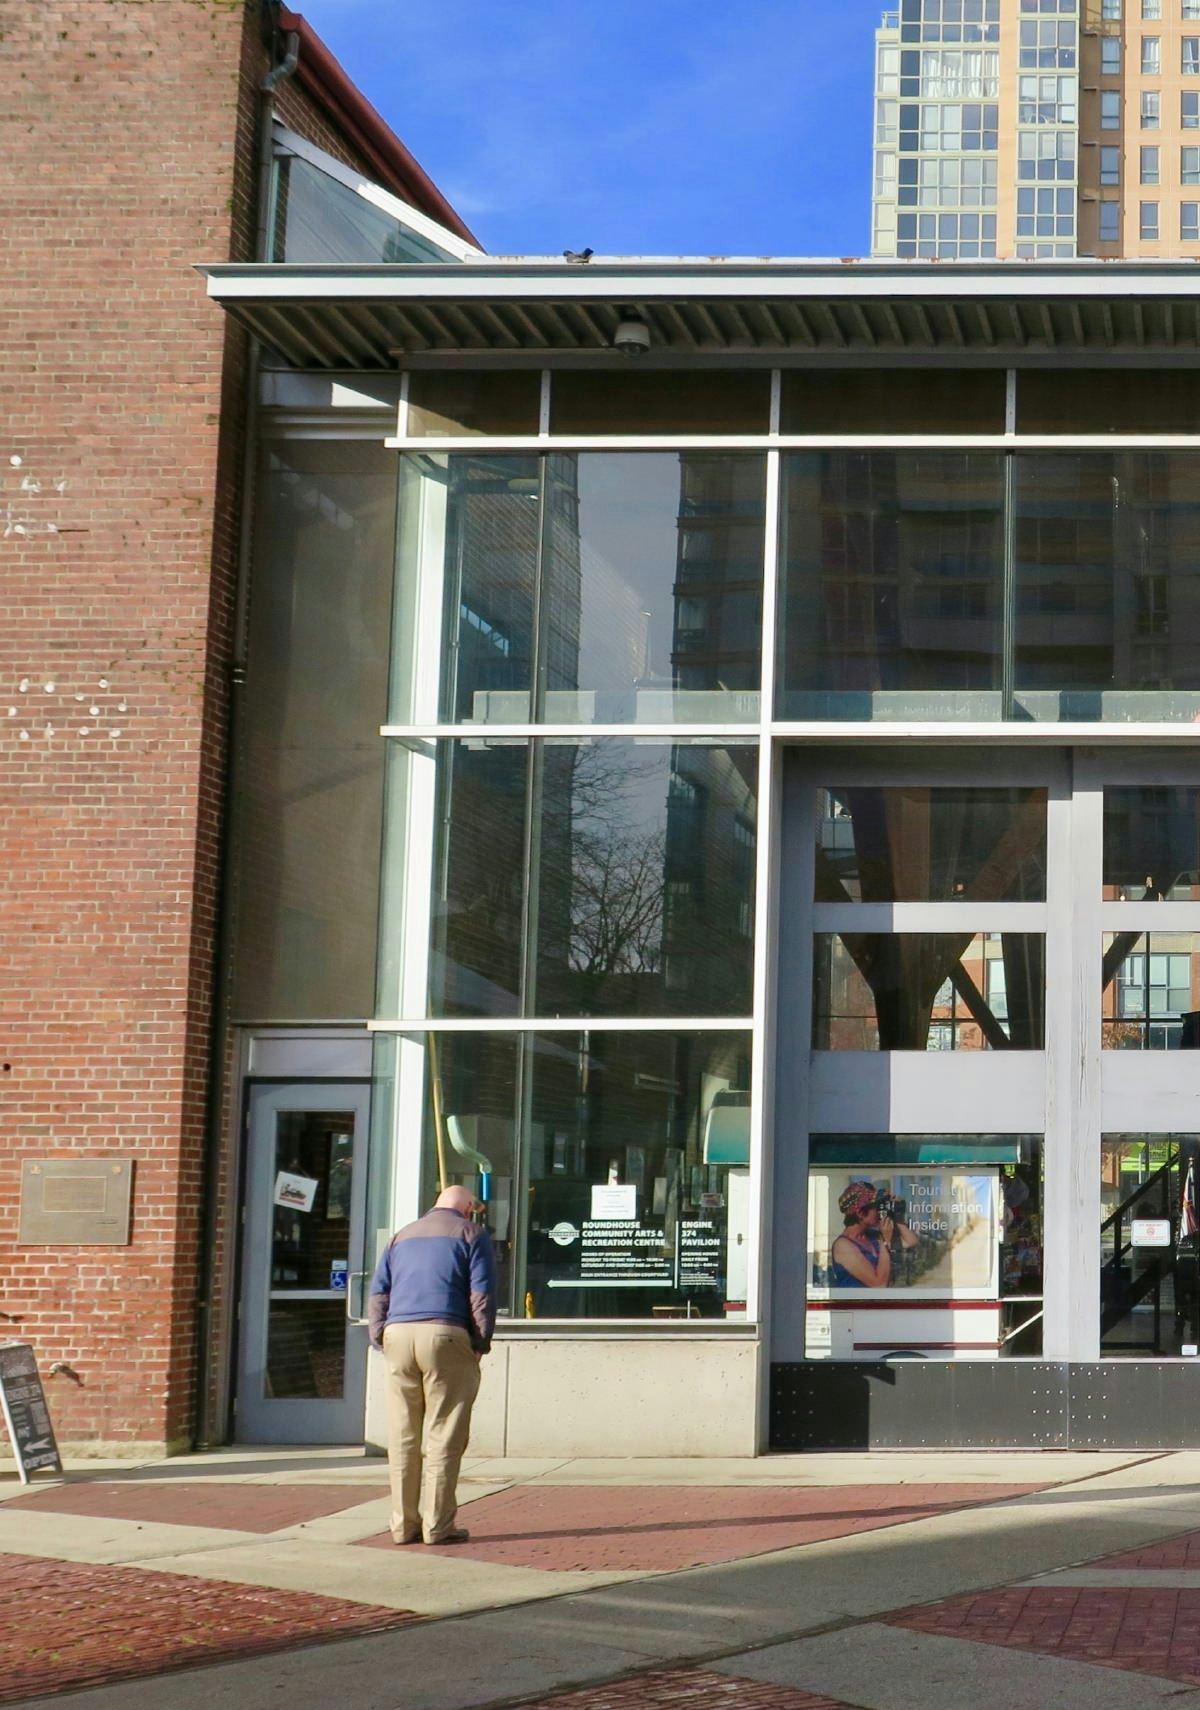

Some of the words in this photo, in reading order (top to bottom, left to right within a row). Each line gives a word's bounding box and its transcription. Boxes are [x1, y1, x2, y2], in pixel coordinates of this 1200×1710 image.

[582, 1221, 641, 1230] ROUNDHOUSE
[681, 1221, 713, 1229] ENGINE
[908, 1218, 948, 1231] Inside
[582, 1230, 633, 1238] COMMUNITY
[634, 1230, 656, 1238] ARTS
[657, 1230, 664, 1238] &
[681, 1230, 697, 1238] 374
[582, 1239, 633, 1247] RECREATION
[633, 1239, 666, 1247] CENTRE
[681, 1238, 721, 1246] PAVILION
